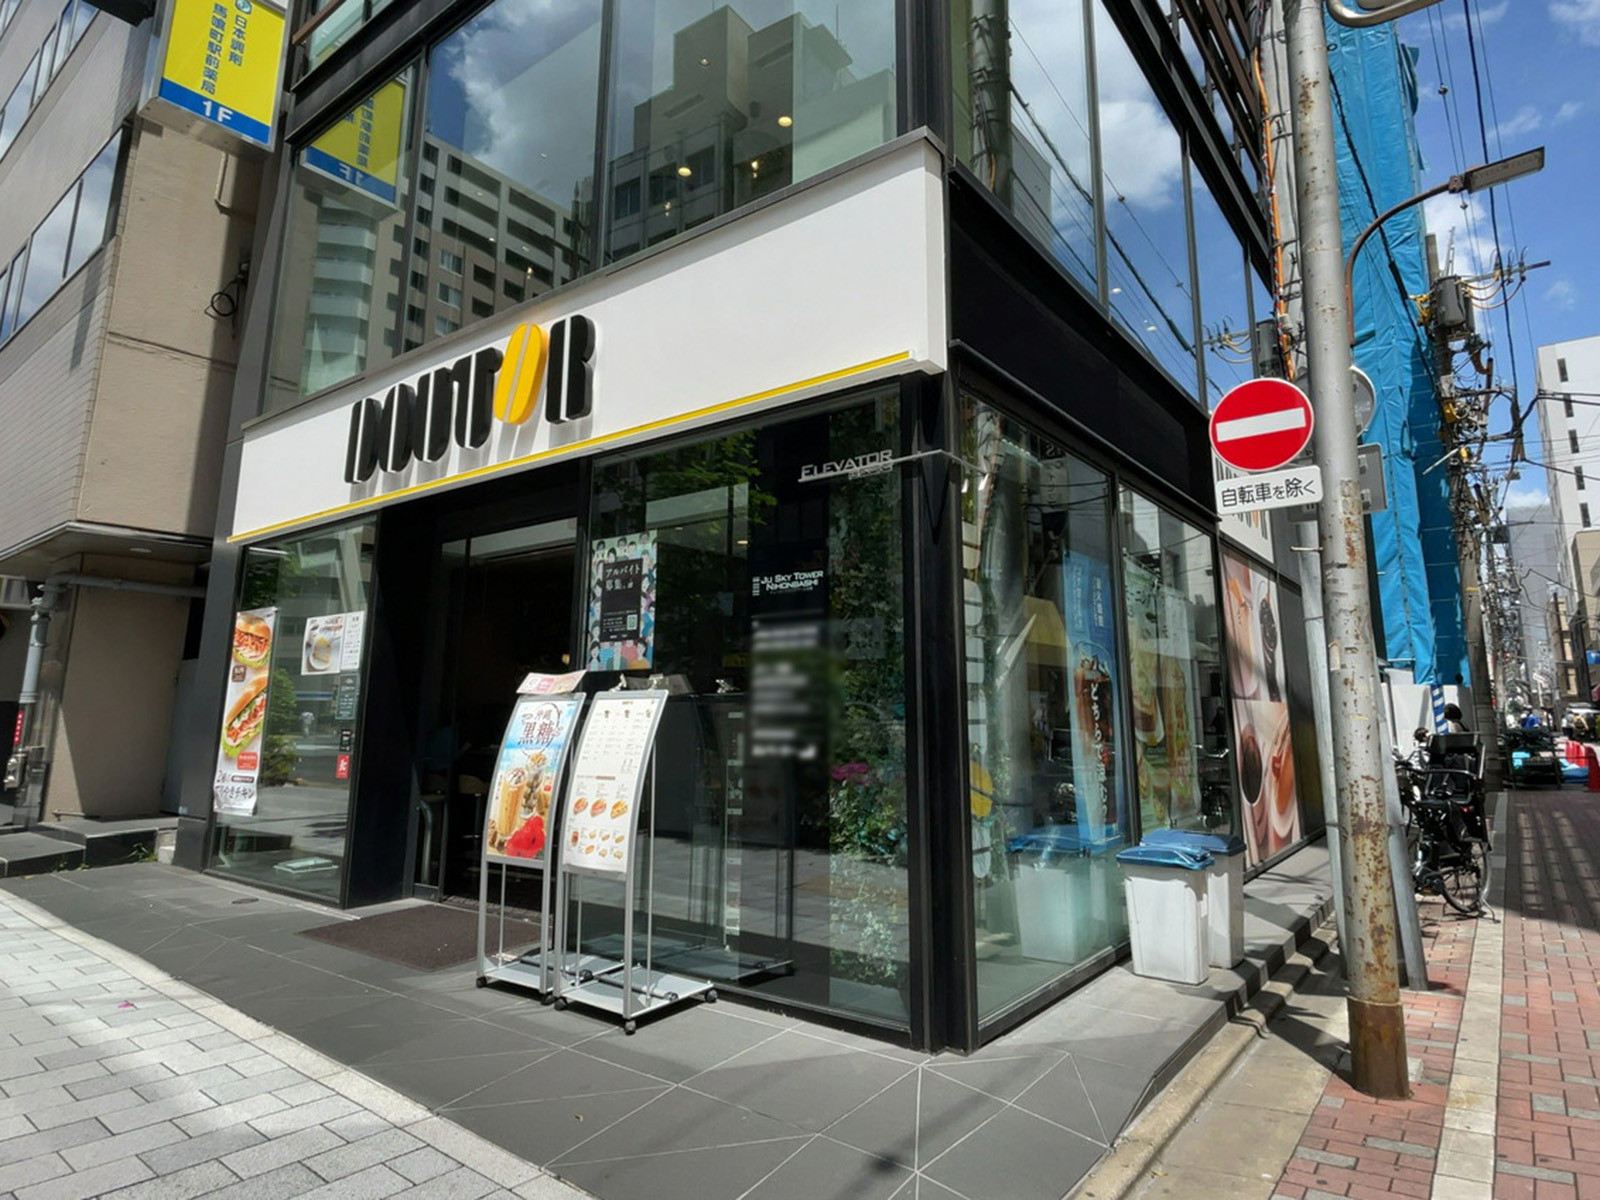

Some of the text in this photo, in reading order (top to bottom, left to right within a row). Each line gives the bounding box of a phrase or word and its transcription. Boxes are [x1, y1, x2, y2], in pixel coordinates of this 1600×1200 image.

[202, 100, 234, 122] 1F
[800, 449, 893, 480] ELEVATOR
[1221, 477, 1316, 507] 自転車を除く
